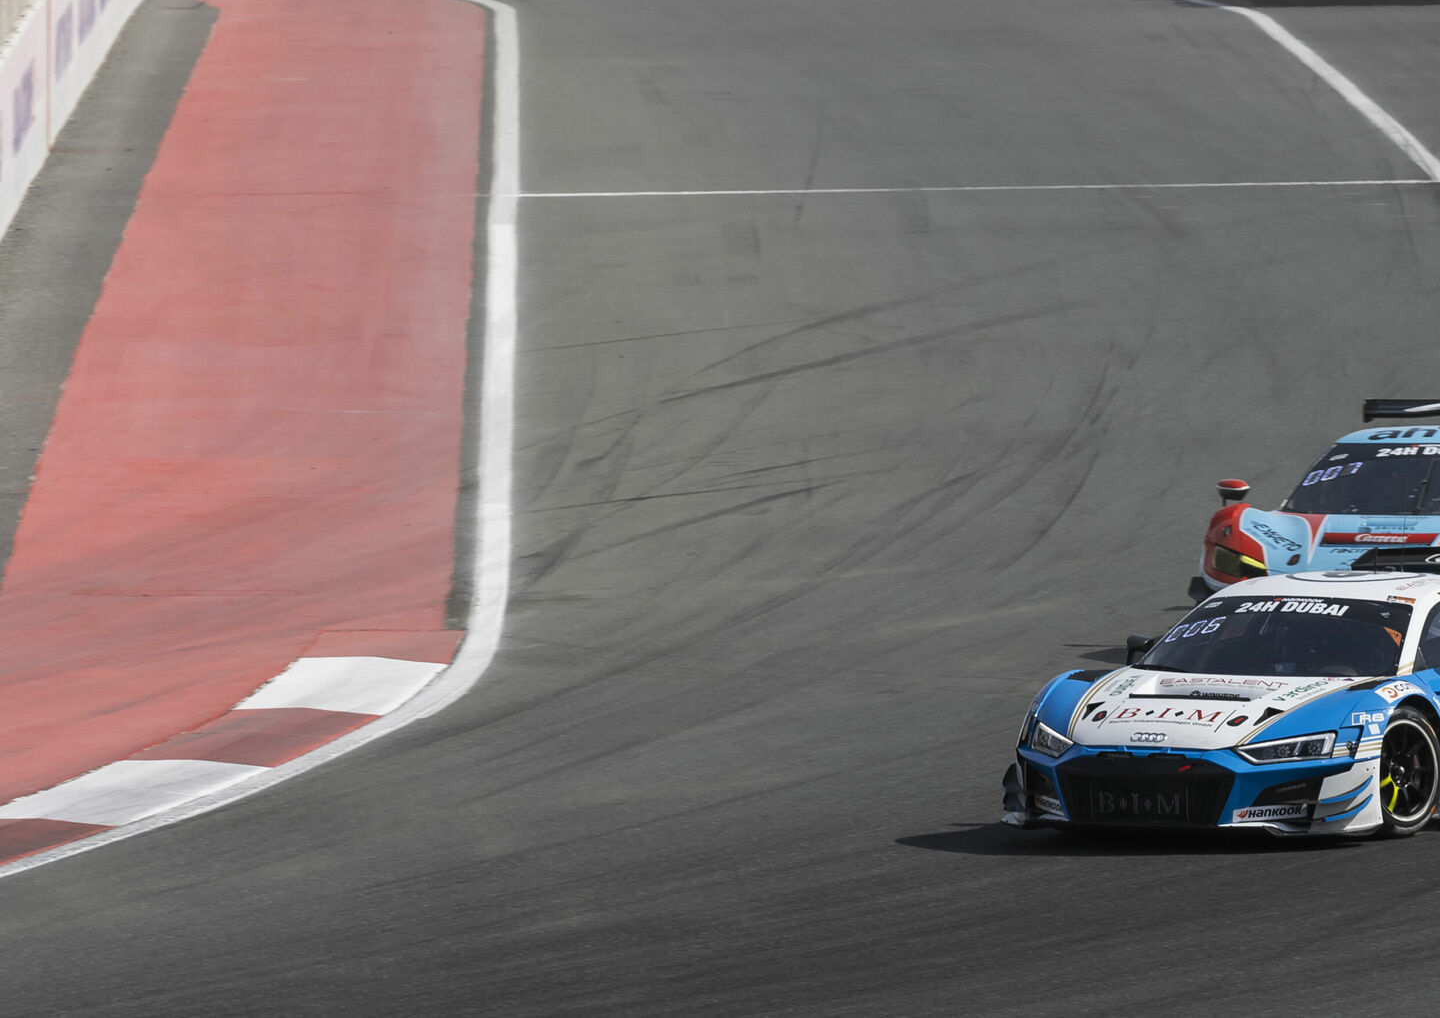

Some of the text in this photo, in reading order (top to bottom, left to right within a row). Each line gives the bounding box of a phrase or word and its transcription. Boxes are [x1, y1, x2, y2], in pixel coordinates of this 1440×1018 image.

[1376, 447, 1419, 457] 24H
[1302, 462, 1364, 486] 007
[1234, 602, 1350, 617] 24H DUBAI
[1165, 616, 1227, 643] 006
[1160, 677, 1289, 688] EASTALENT
